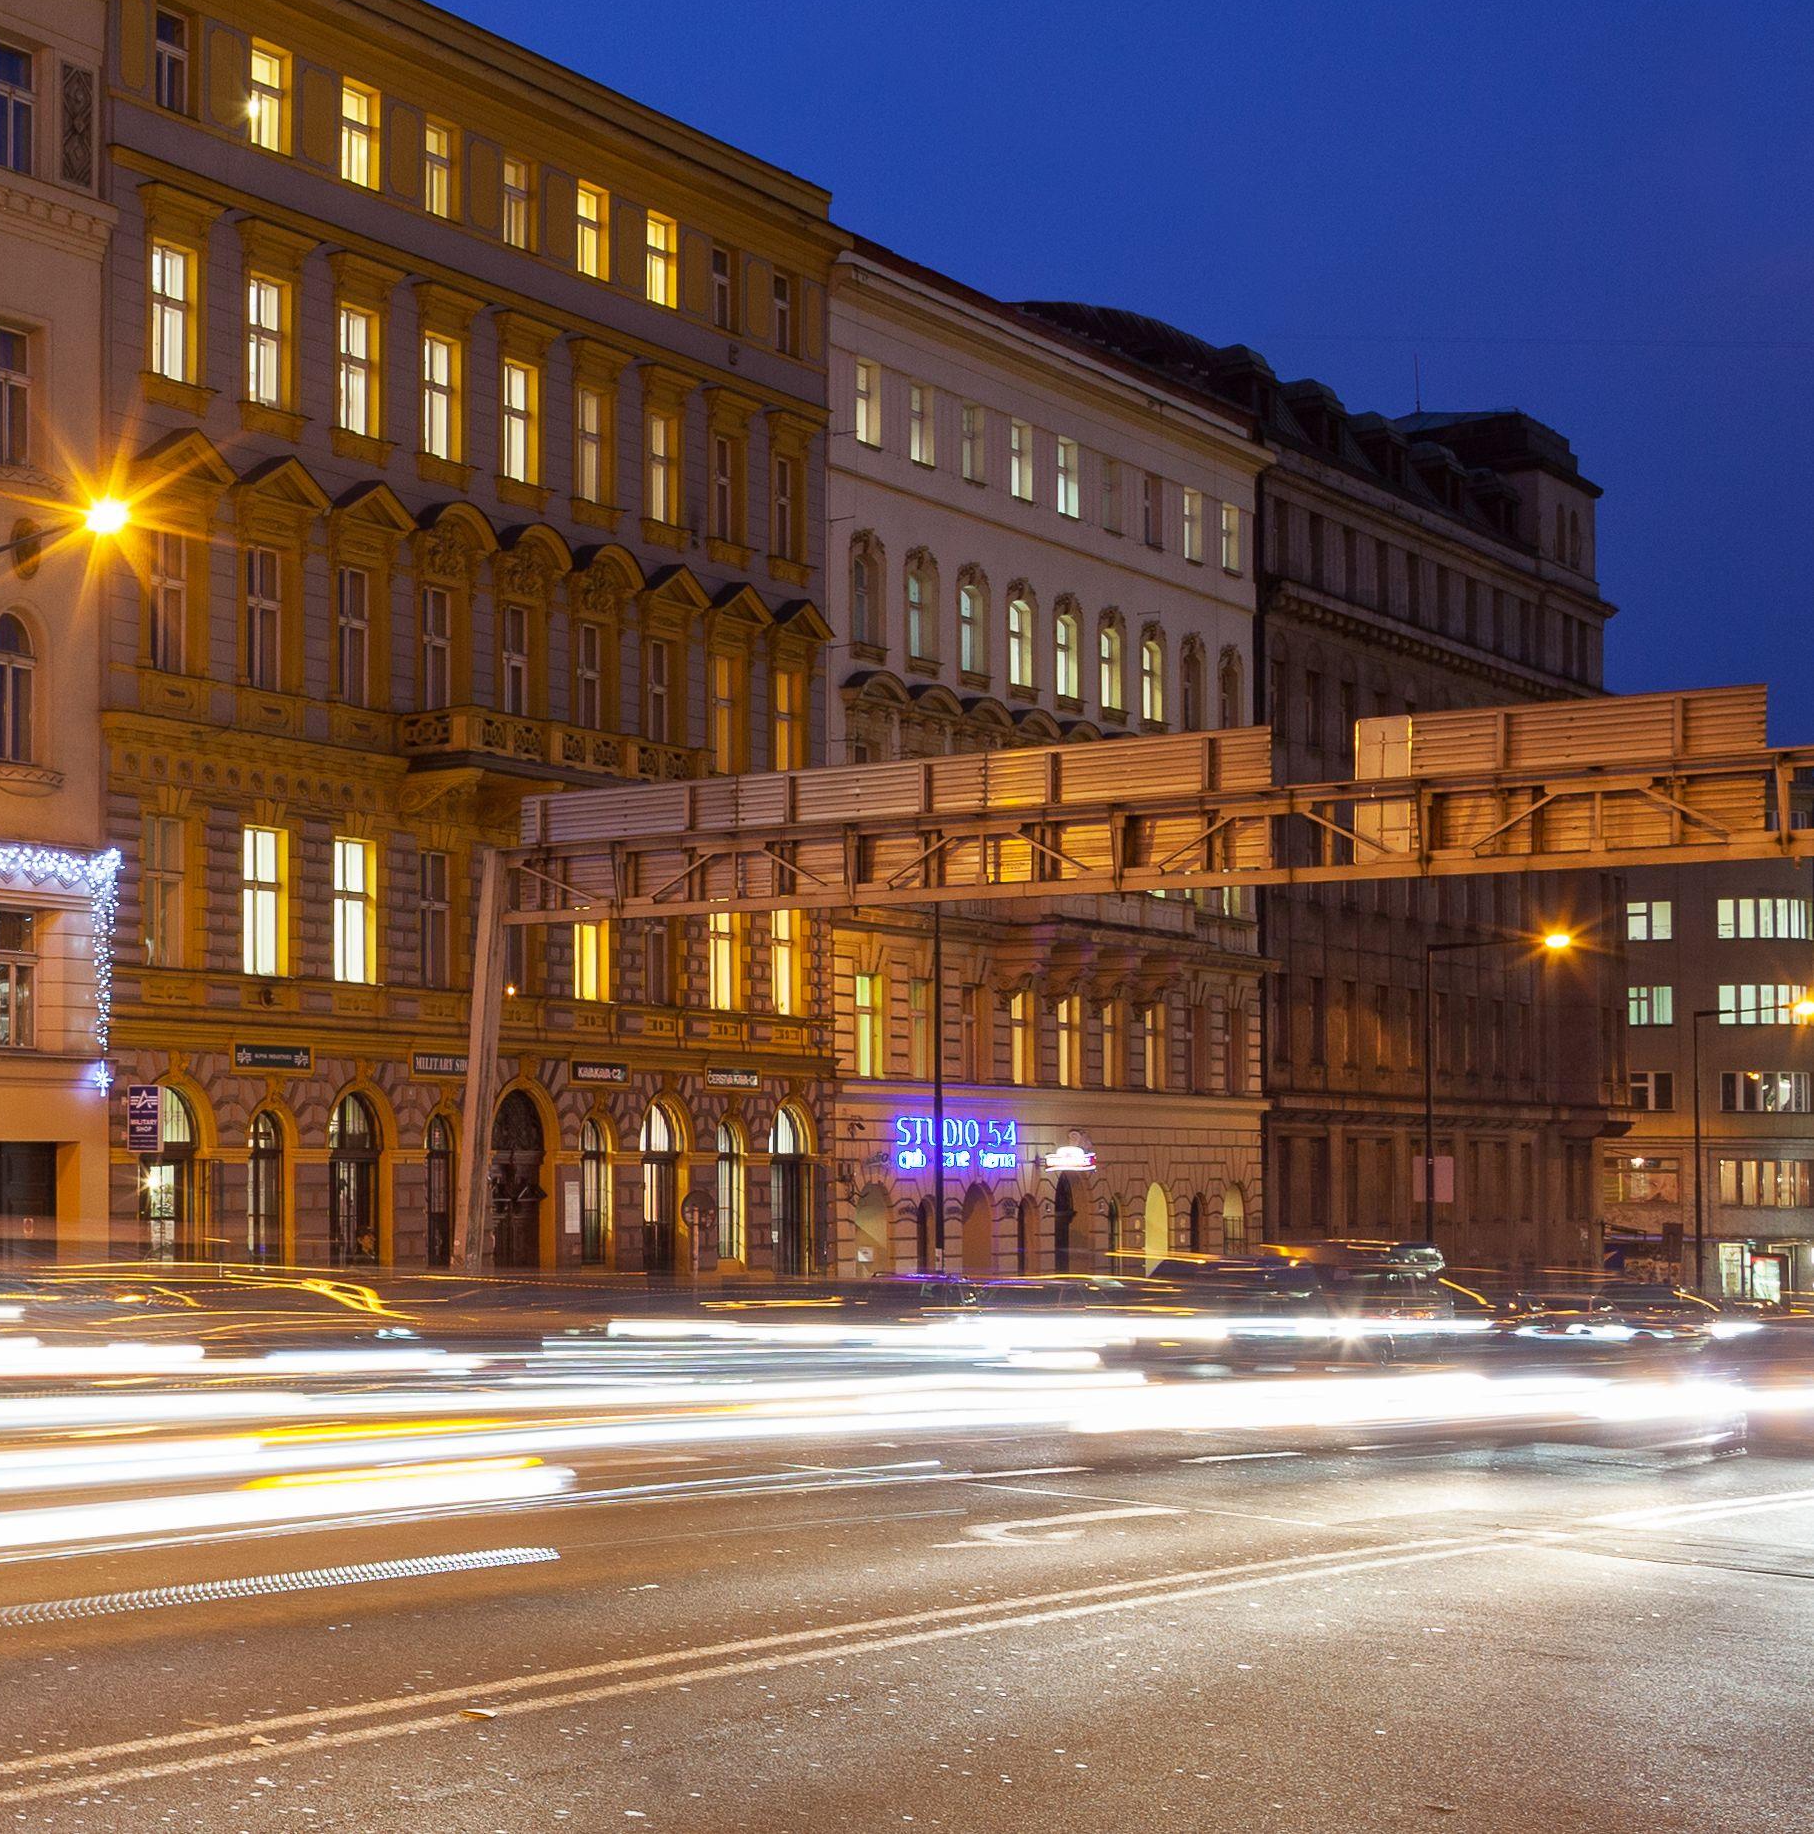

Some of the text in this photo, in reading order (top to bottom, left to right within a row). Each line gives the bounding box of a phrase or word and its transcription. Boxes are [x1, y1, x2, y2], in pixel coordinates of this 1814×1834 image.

[415, 1056, 469, 1072] MILITARY SHO
[896, 1117, 1017, 1148] STUDIO 54
